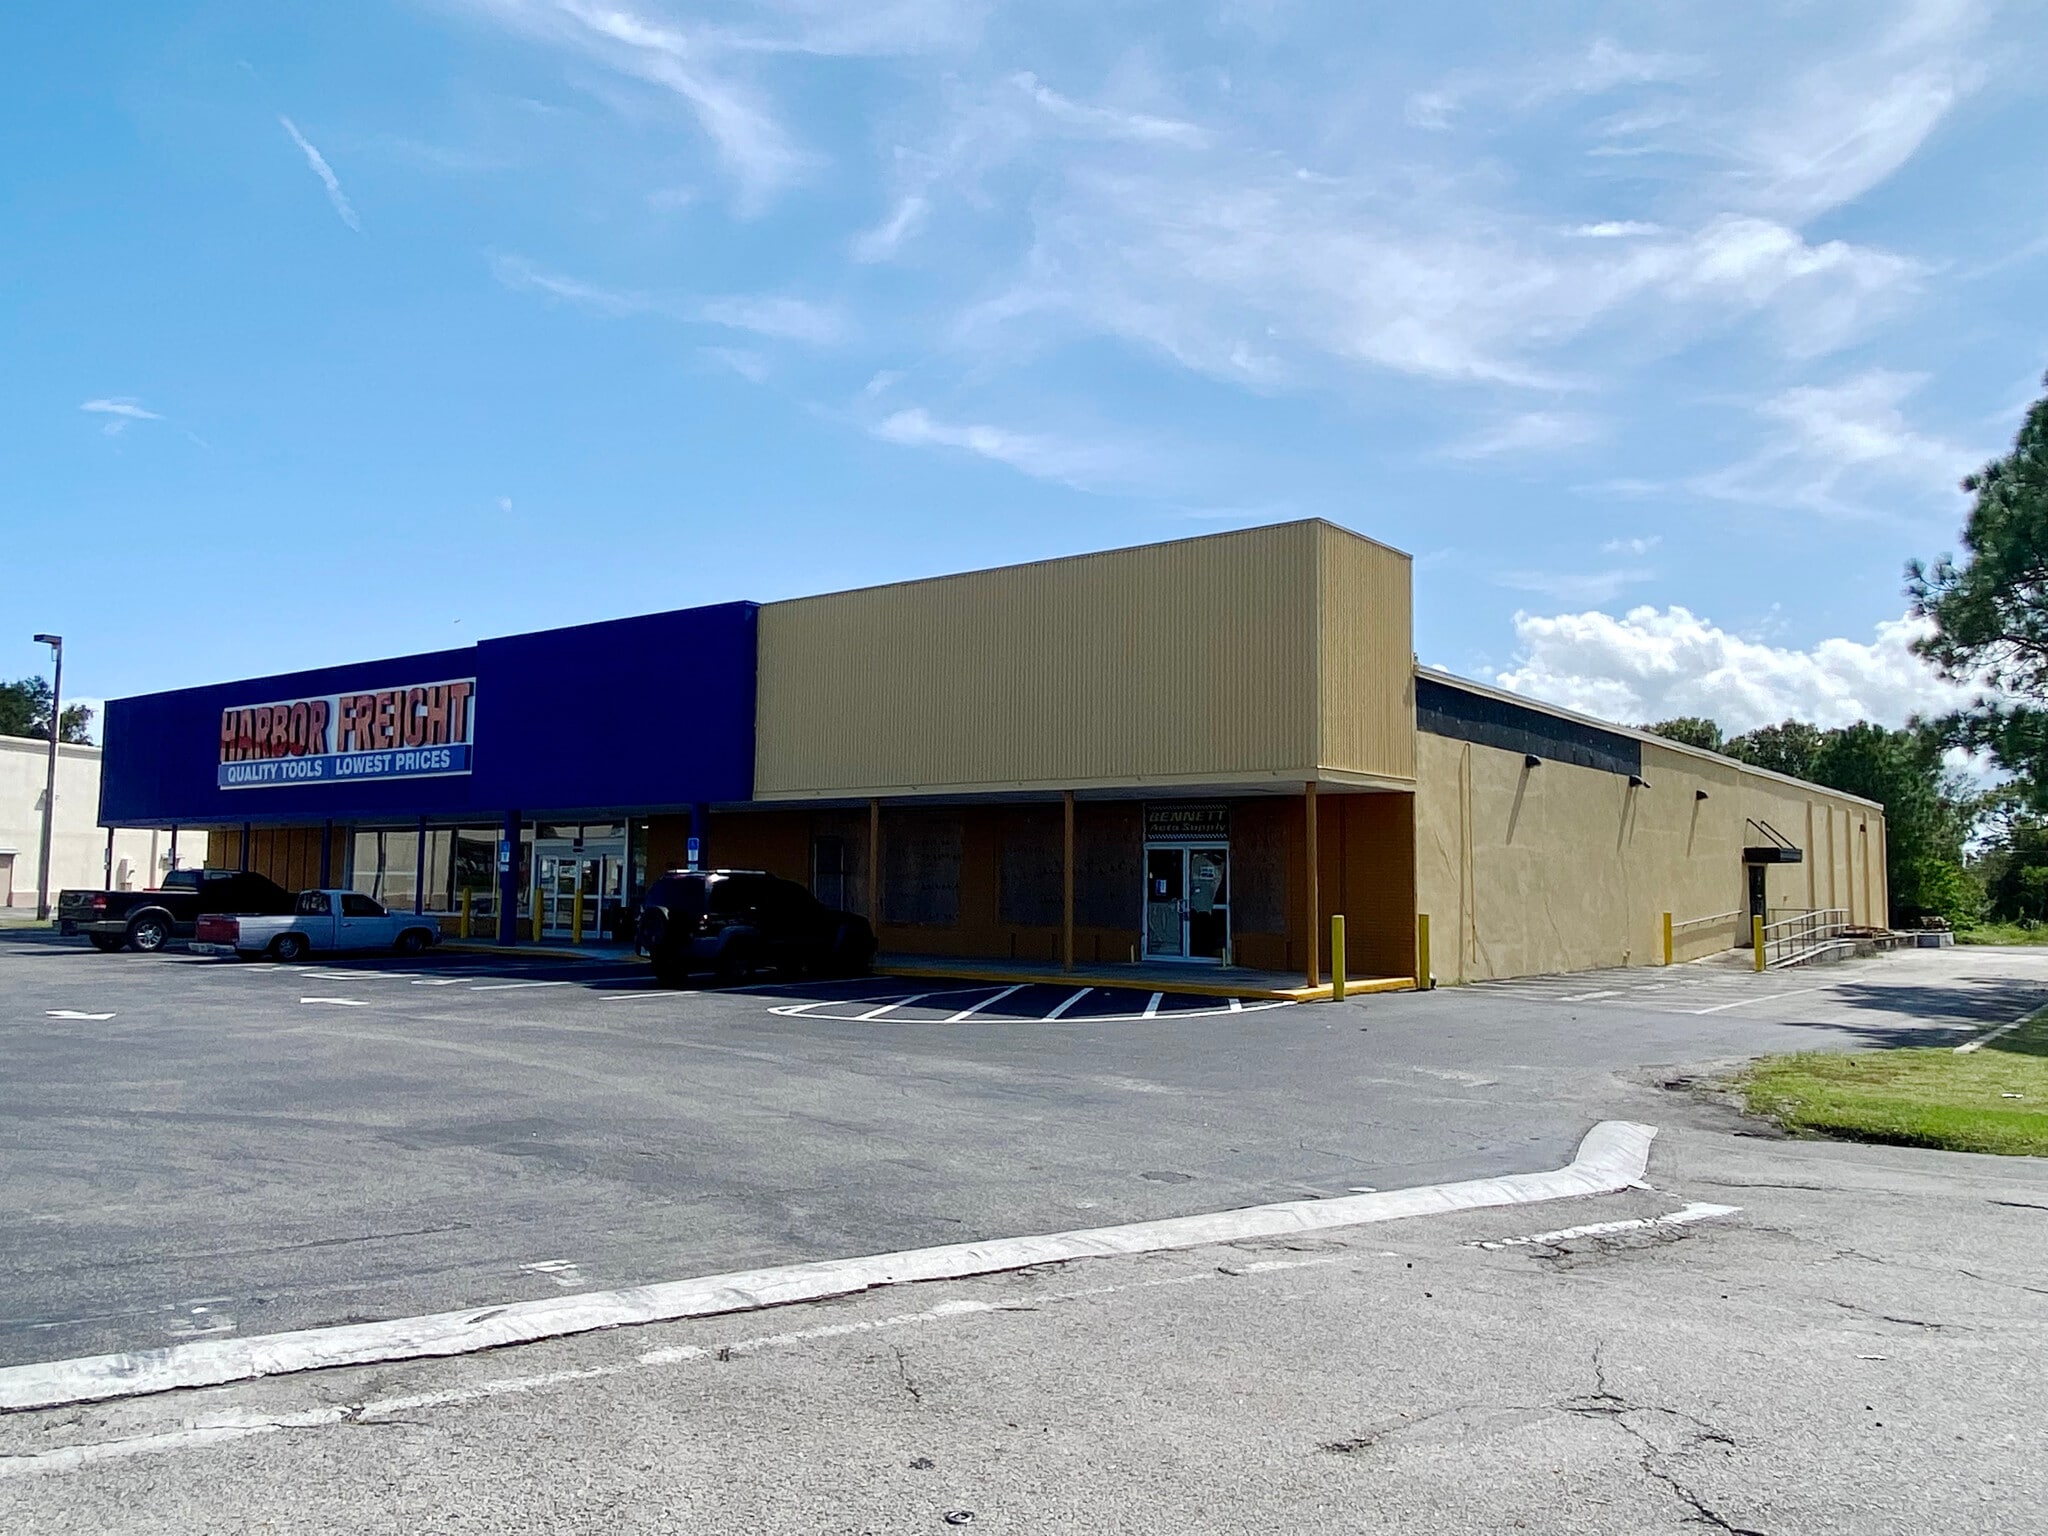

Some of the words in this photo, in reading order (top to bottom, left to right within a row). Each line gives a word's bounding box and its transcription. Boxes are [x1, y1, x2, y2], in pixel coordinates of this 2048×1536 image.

[220, 699, 329, 762] HARBOR
[336, 681, 475, 752] FREIGHT
[227, 763, 279, 783] QUALITY
[281, 759, 323, 778] TOOLS
[335, 754, 390, 776] LOWEST
[395, 749, 451, 771] PRICES
[1149, 810, 1226, 822] BENNETT
[1150, 823, 1180, 832] Auto
[1182, 822, 1227, 832] Supply
